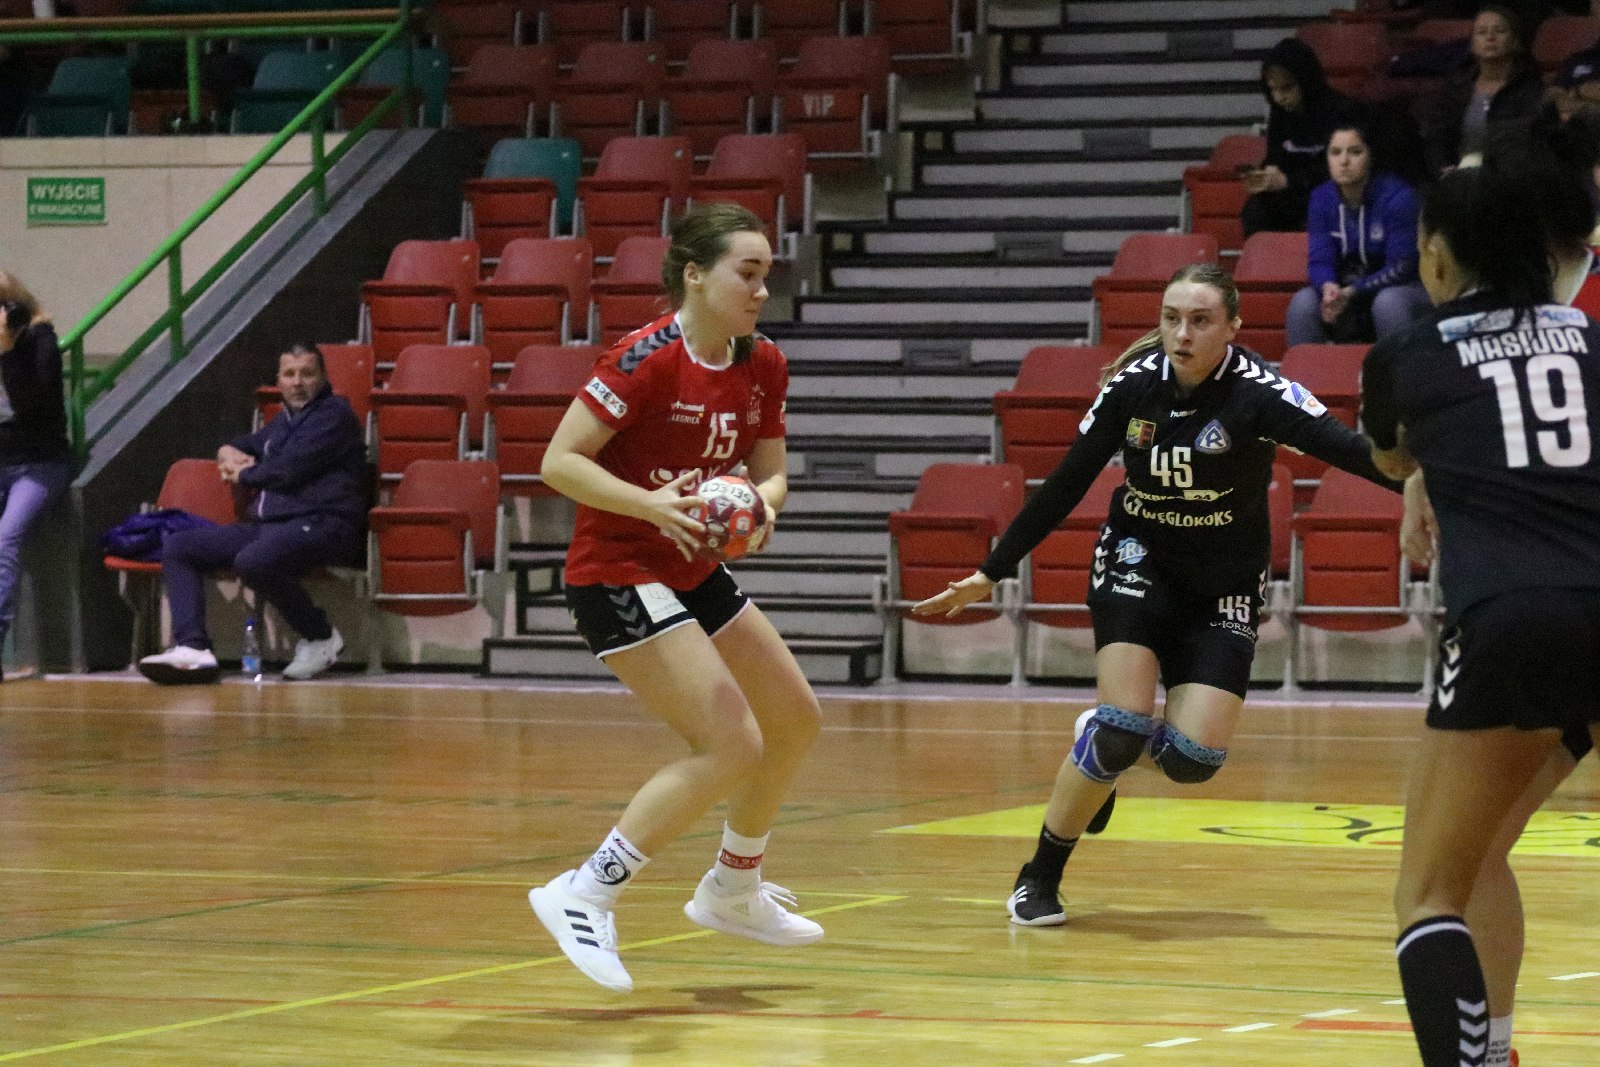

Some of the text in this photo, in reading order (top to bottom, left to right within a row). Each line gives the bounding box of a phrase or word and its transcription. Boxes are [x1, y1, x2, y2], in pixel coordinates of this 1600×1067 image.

[803, 94, 834, 117] VIP
[671, 413, 700, 424] LEGNICA
[1478, 354, 1591, 468] 19
[702, 412, 739, 459] 15
[1151, 445, 1193, 488] 45
[1218, 596, 1250, 623] 45
